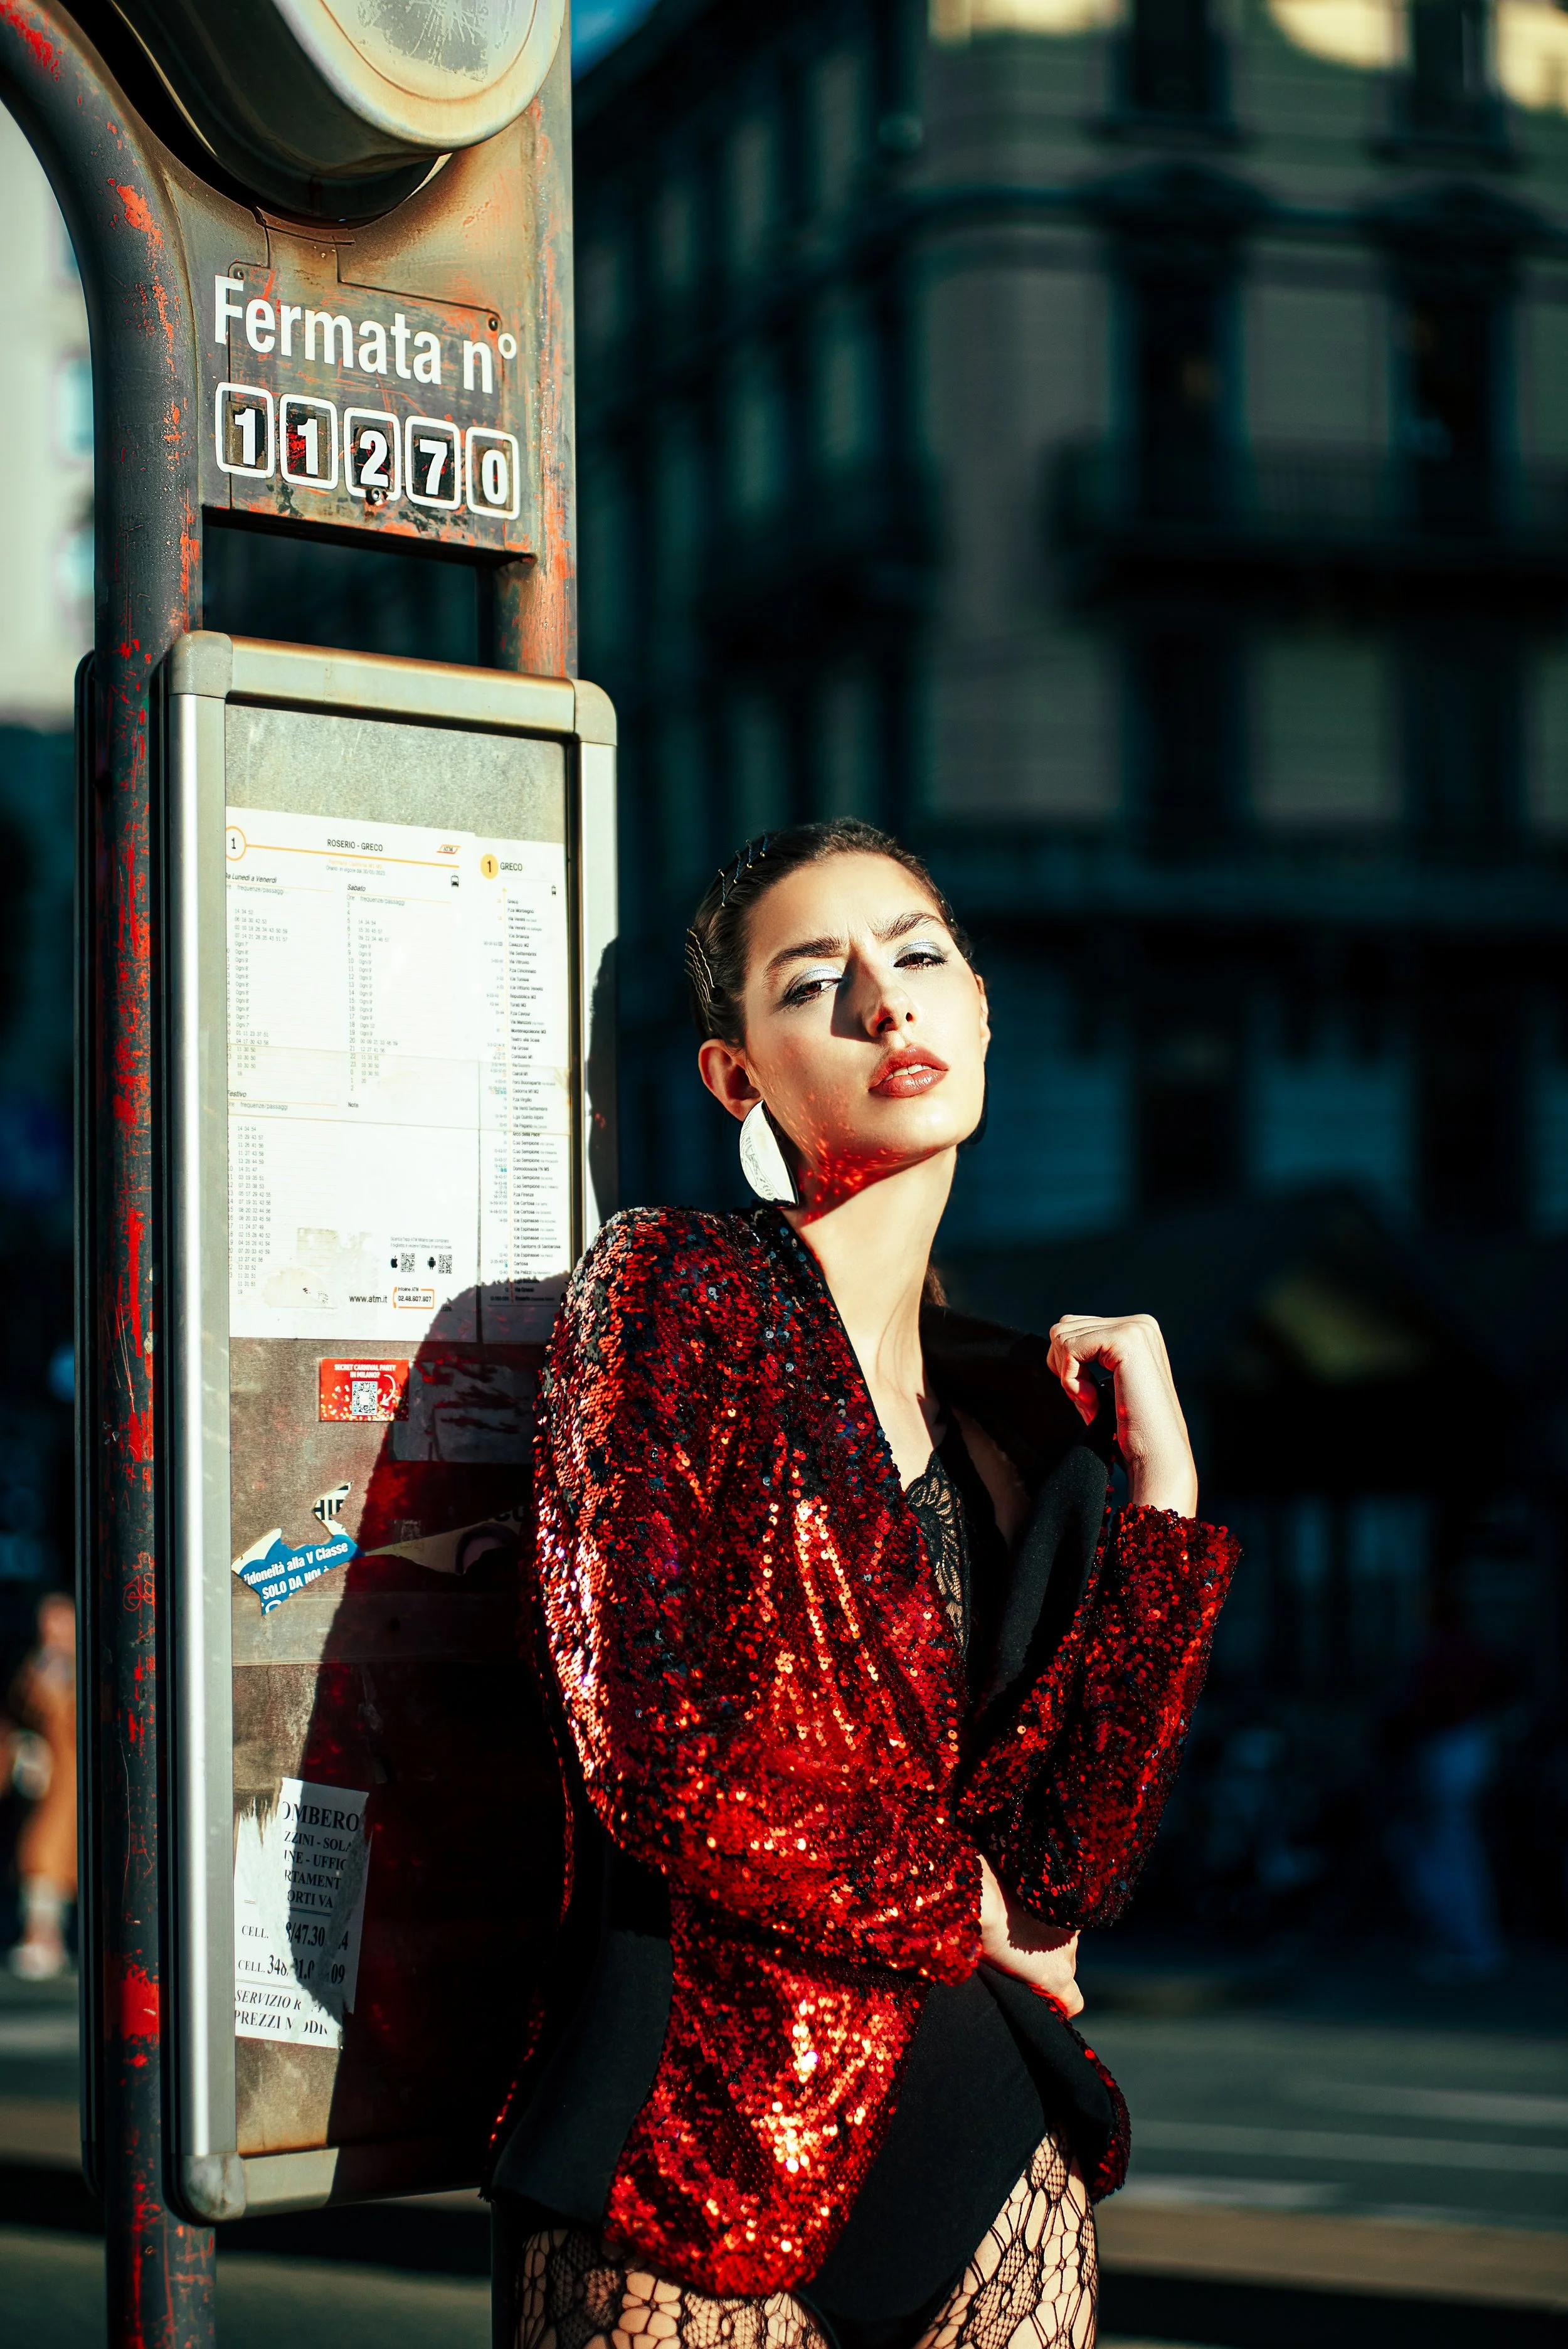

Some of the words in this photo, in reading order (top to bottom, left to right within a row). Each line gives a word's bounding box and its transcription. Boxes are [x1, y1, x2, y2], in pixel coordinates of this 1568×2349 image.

[215, 275, 442, 385] Fermata
[463, 332, 517, 395] n°
[231, 837, 236, 849] 1
[327, 839, 356, 849] ROSERIO
[361, 842, 383, 852] GRECO
[487, 859, 491, 872] 1
[501, 862, 522, 871] GRECO
[349, 1295, 388, 1303] www.atm.it
[334, 1364, 354, 1372] SECRET
[354, 1364, 379, 1372] CARNIVAL
[379, 1364, 396, 1372] PARTY
[287, 1556, 305, 1572] alla
[305, 1551, 314, 1564] V
[315, 1542, 348, 1561] Classe
[262, 1580, 287, 1599] SOLO
[288, 1574, 304, 1590] DA
[285, 1869, 342, 1890] RTAMENT
[287, 1889, 315, 1906] ORTI
[319, 1896, 333, 1908] VA
[241, 1925, 269, 1939] CELL.
[238, 1959, 265, 1973] CELL.
[234, 1989, 291, 2009] SERVIZIO
[235, 2010, 282, 2030] PREZZI
